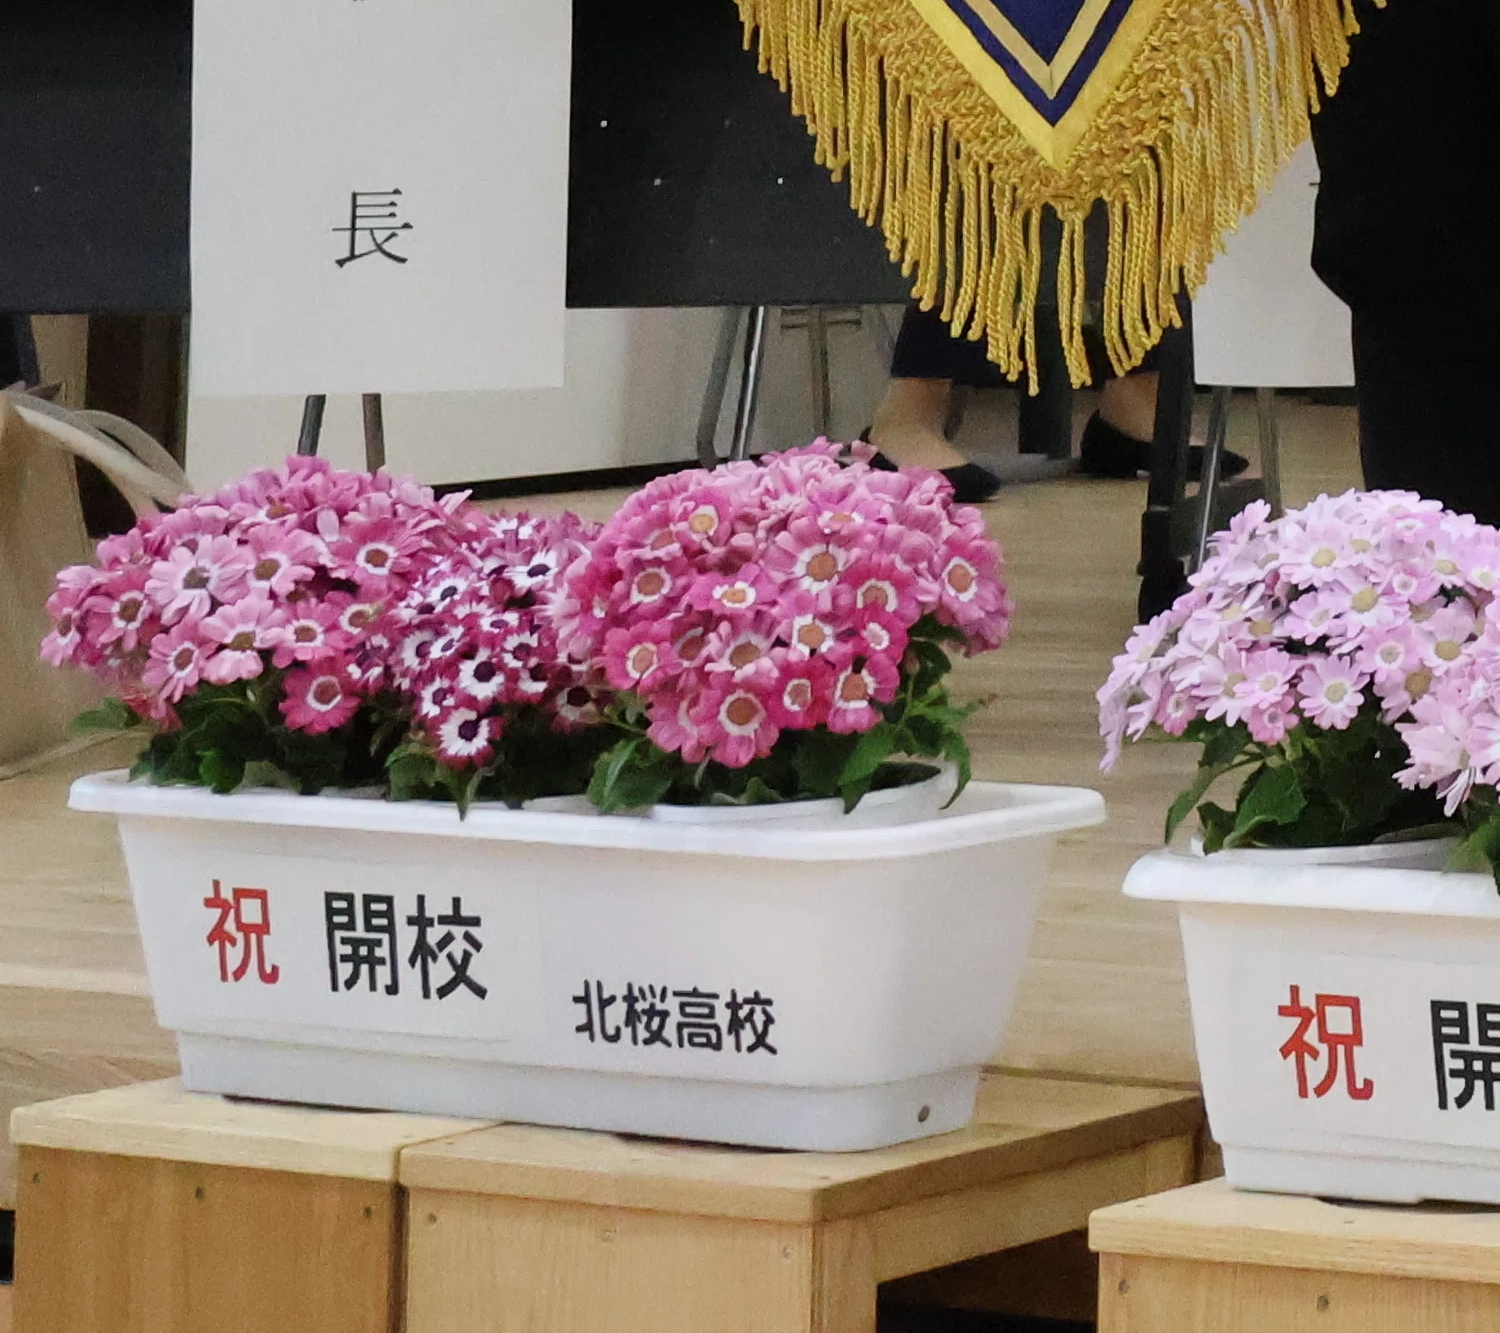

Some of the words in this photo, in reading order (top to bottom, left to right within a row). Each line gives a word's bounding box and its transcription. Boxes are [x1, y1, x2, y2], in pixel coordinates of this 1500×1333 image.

[204, 879, 281, 985] 祝
[324, 891, 488, 1002] 開校
[572, 979, 779, 1057] 北桜高校
[1278, 985, 1375, 1101] 祝
